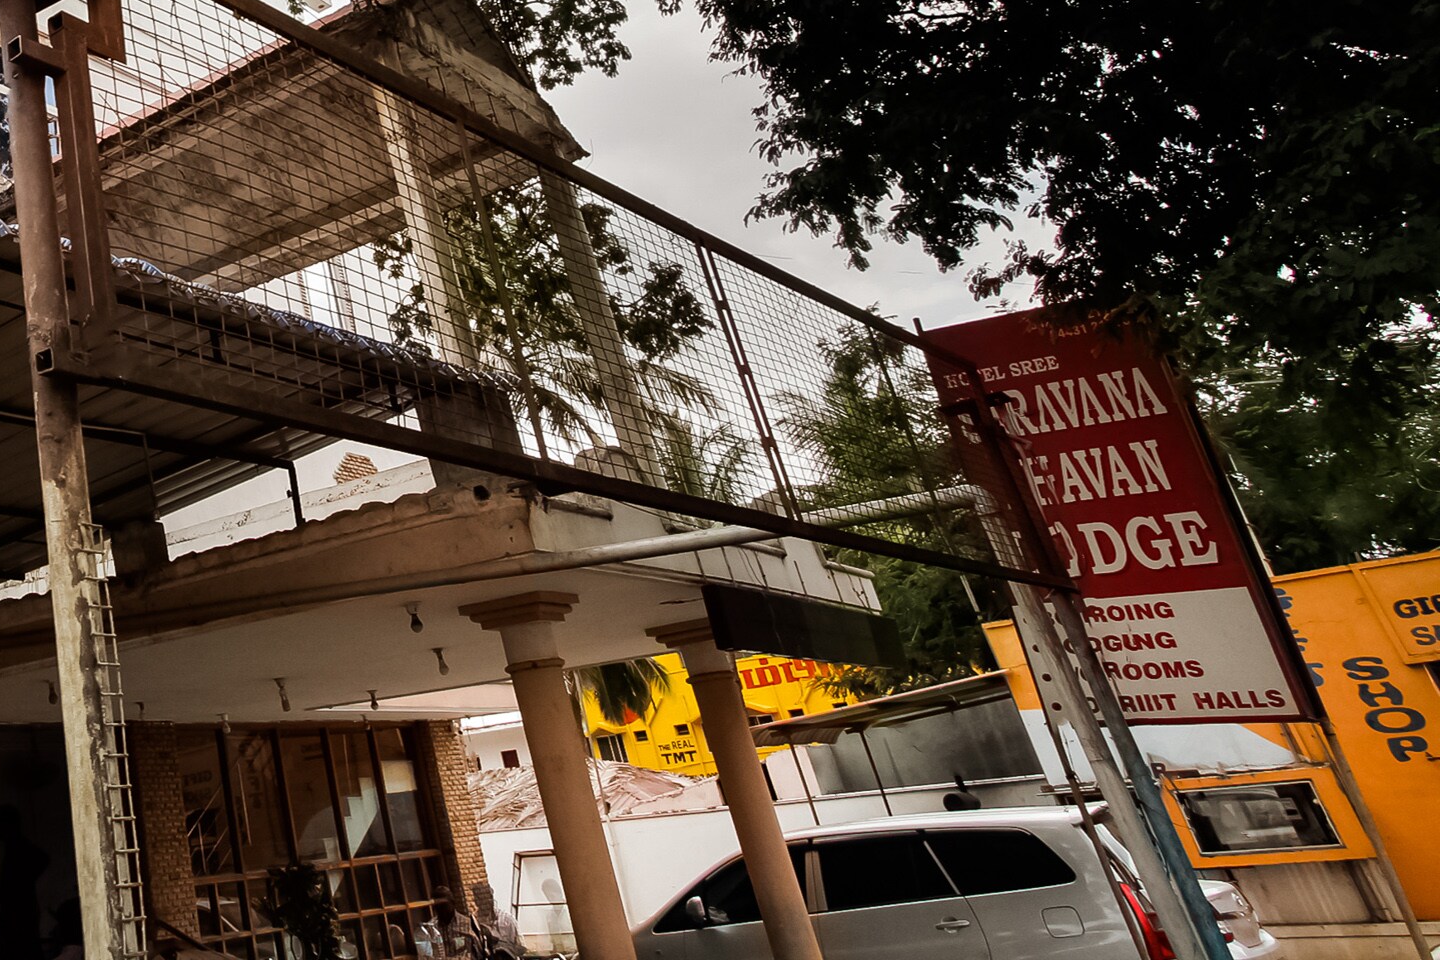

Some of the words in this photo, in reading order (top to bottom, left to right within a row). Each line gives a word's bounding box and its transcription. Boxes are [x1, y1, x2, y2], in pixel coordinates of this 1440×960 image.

[944, 366, 1005, 388] HOEL
[1009, 356, 1059, 377] SREE
[956, 367, 1167, 444] RAVANA
[1013, 510, 1220, 578] DGE
[1101, 659, 1206, 681] ROOMS
[1193, 689, 1287, 710] HALLS
[1342, 656, 1429, 762] SHOP
[658, 743, 671, 751] THE
[671, 739, 695, 750] REAL
[661, 750, 697, 765] TMT
